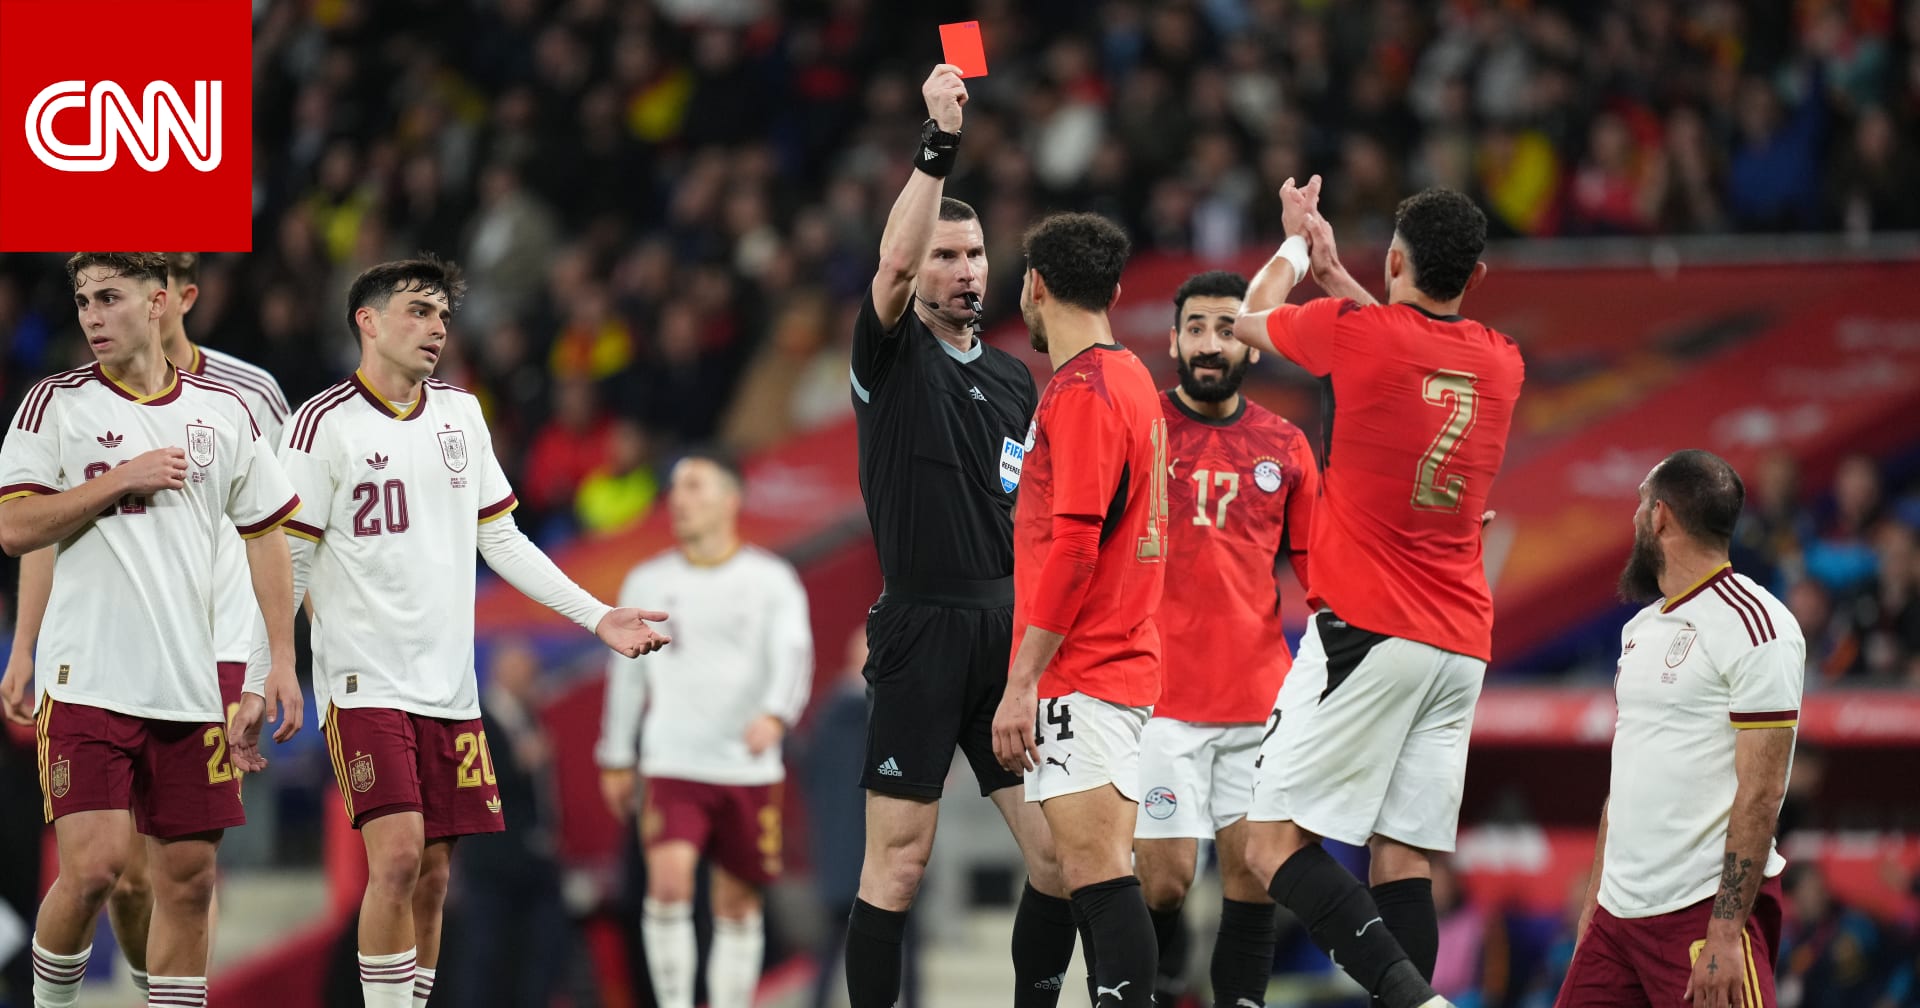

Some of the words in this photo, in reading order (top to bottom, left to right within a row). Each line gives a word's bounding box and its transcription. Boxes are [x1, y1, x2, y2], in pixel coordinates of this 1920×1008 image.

[1004, 441, 1023, 460] FIFA
[1411, 368, 1479, 514] 2
[1002, 461, 1021, 475] REFEREE
[353, 479, 409, 537] 20
[1192, 469, 1239, 529] 17
[877, 768, 903, 777] adidas
